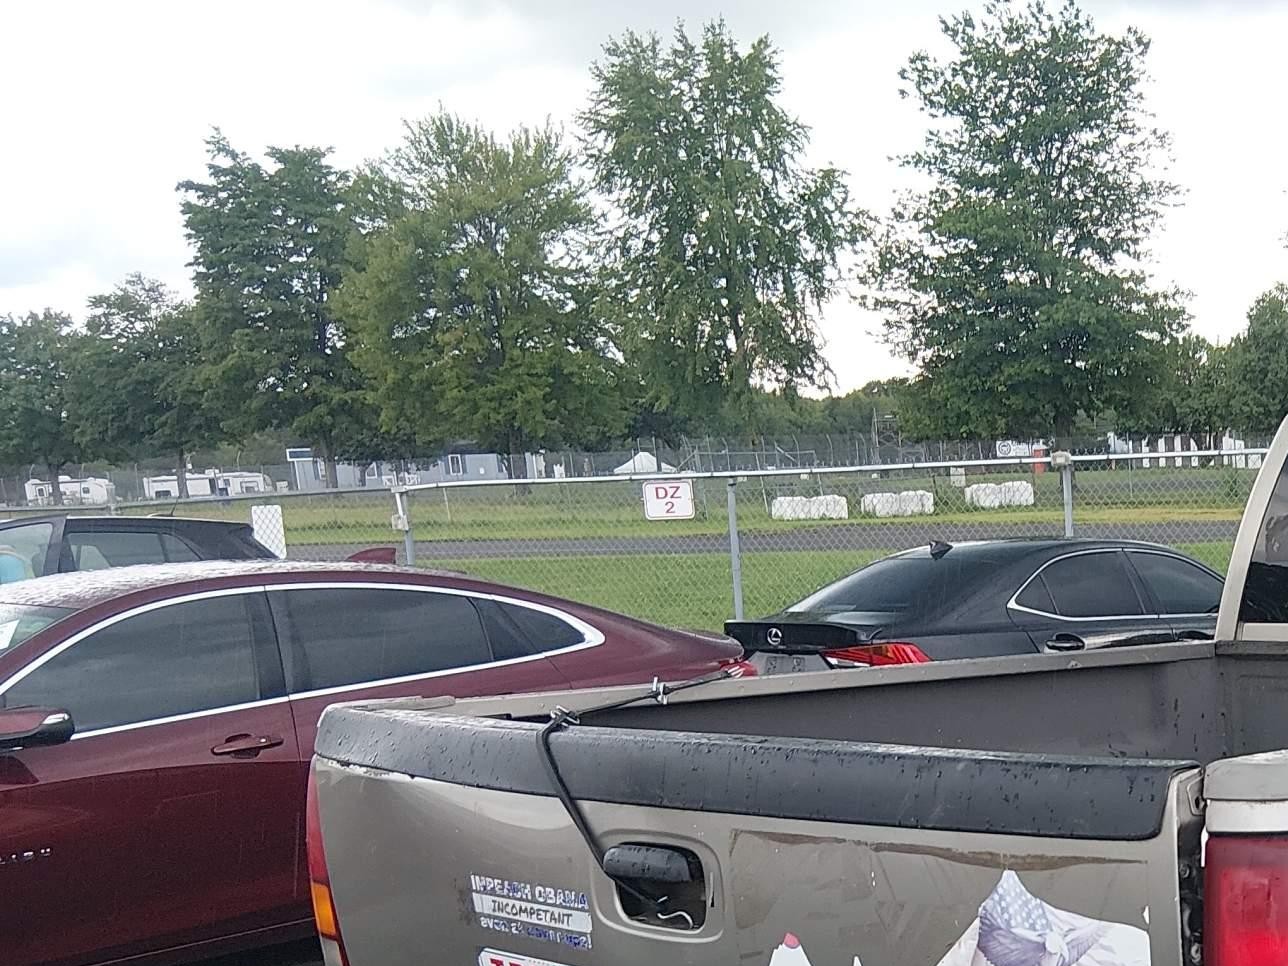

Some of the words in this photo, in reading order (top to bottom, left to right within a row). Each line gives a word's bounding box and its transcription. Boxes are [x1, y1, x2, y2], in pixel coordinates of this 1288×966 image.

[655, 486, 682, 500] DZ
[665, 501, 676, 513] 2
[491, 899, 573, 927] INCOMPETANT
